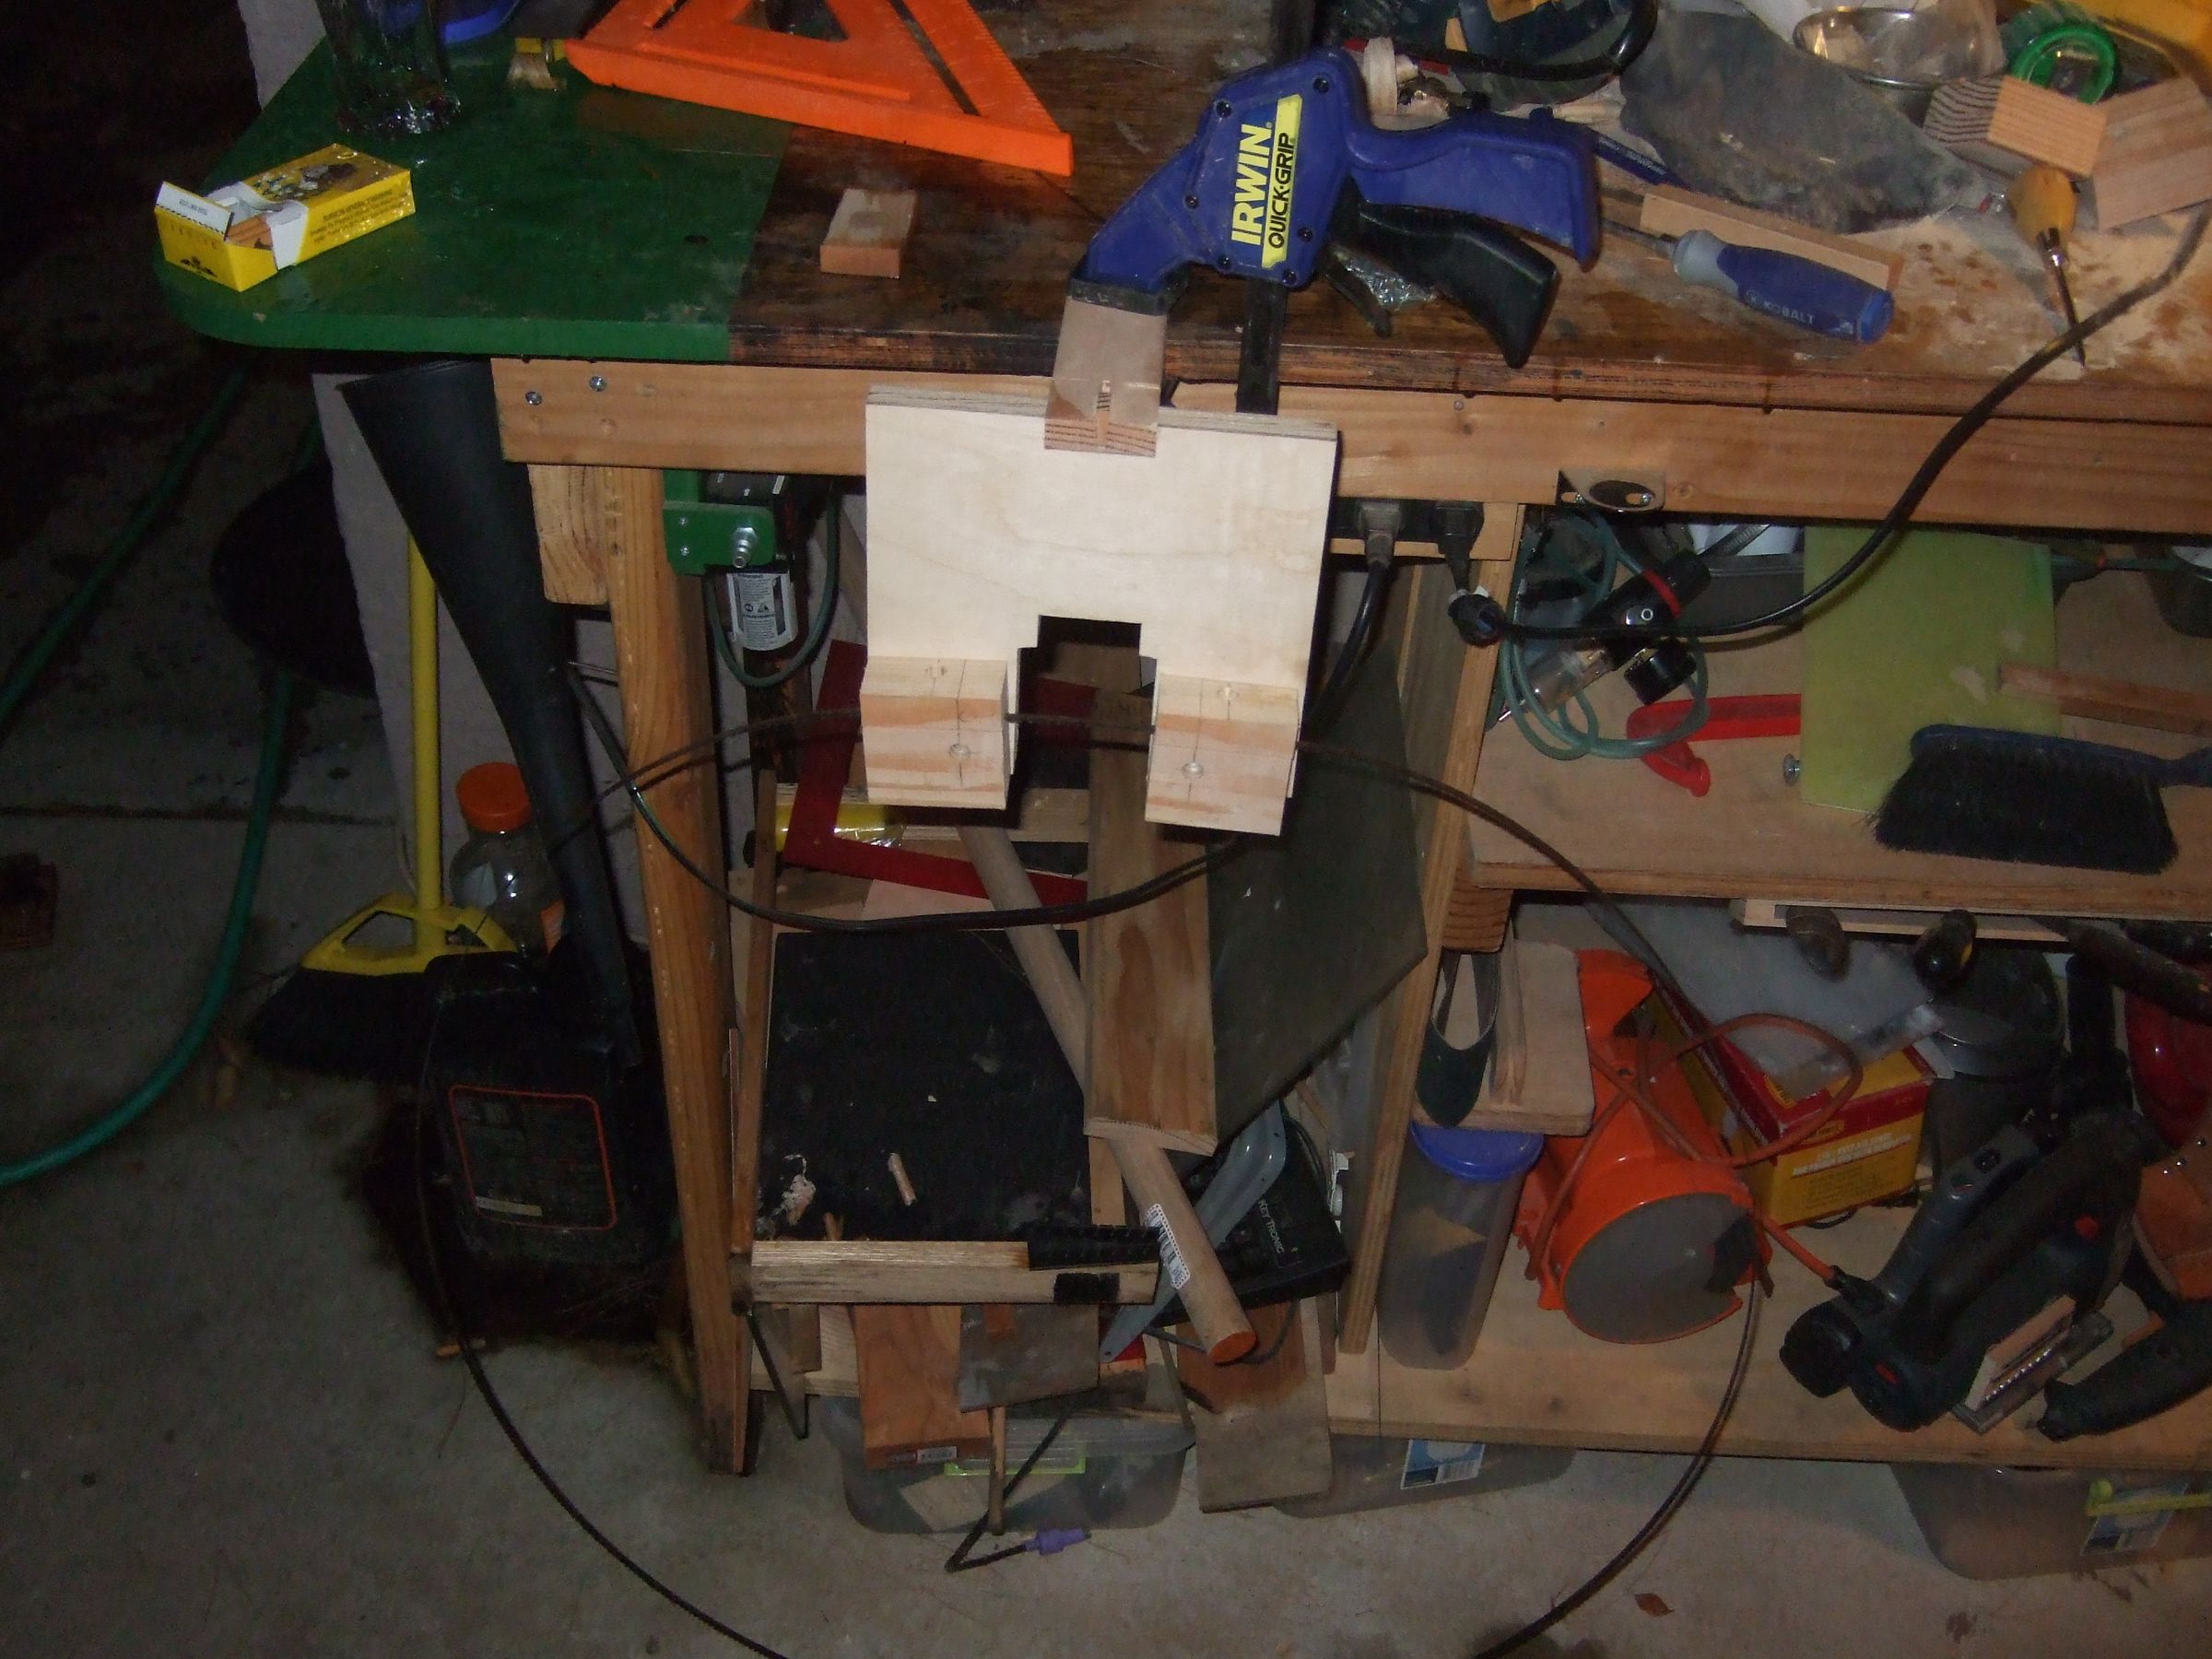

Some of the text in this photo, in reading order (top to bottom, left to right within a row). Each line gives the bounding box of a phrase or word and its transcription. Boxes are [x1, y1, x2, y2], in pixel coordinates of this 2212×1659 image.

[1231, 124, 1273, 245] IRWIN
[1763, 300, 1815, 324] KOBALT
[1258, 1200, 1285, 1253] KEY TRONIC
